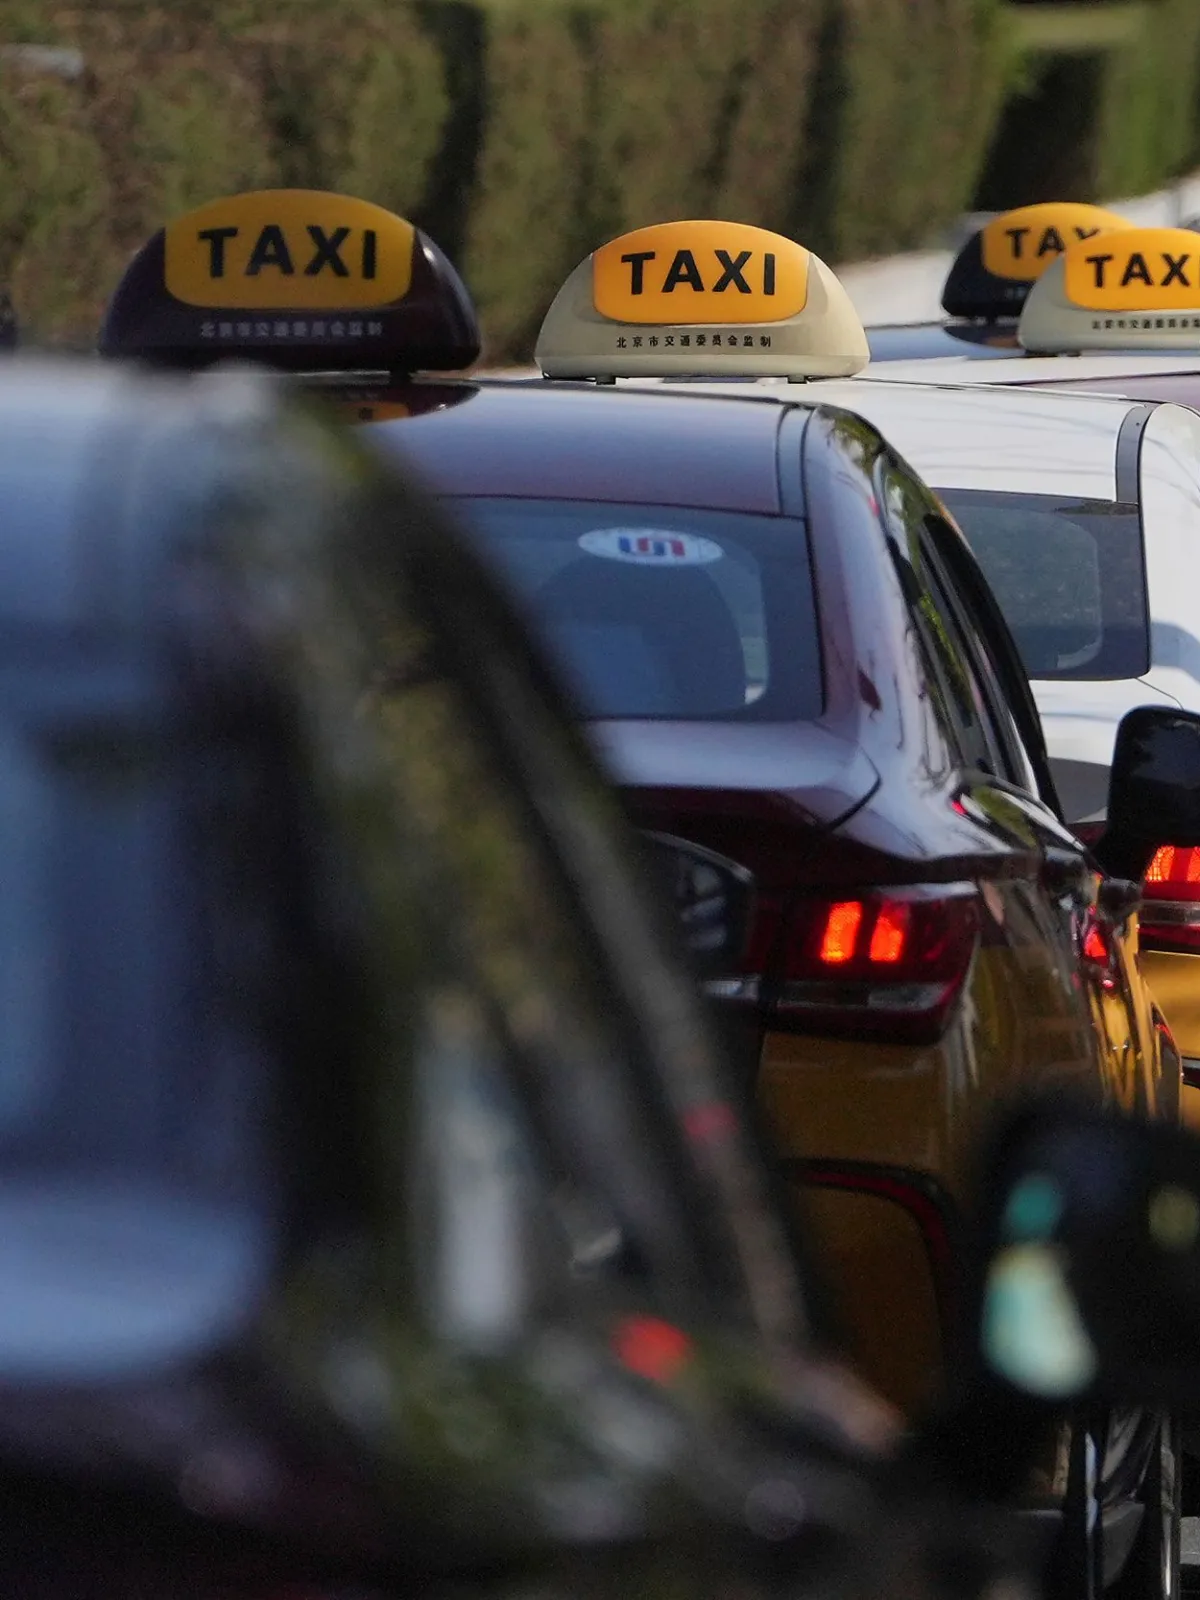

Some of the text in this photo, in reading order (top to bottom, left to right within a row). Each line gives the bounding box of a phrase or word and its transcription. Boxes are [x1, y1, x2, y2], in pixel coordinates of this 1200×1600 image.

[198, 225, 377, 279] TAXI
[621, 250, 776, 296] TAXI
[616, 334, 772, 349] 北京市交通委员会监制
